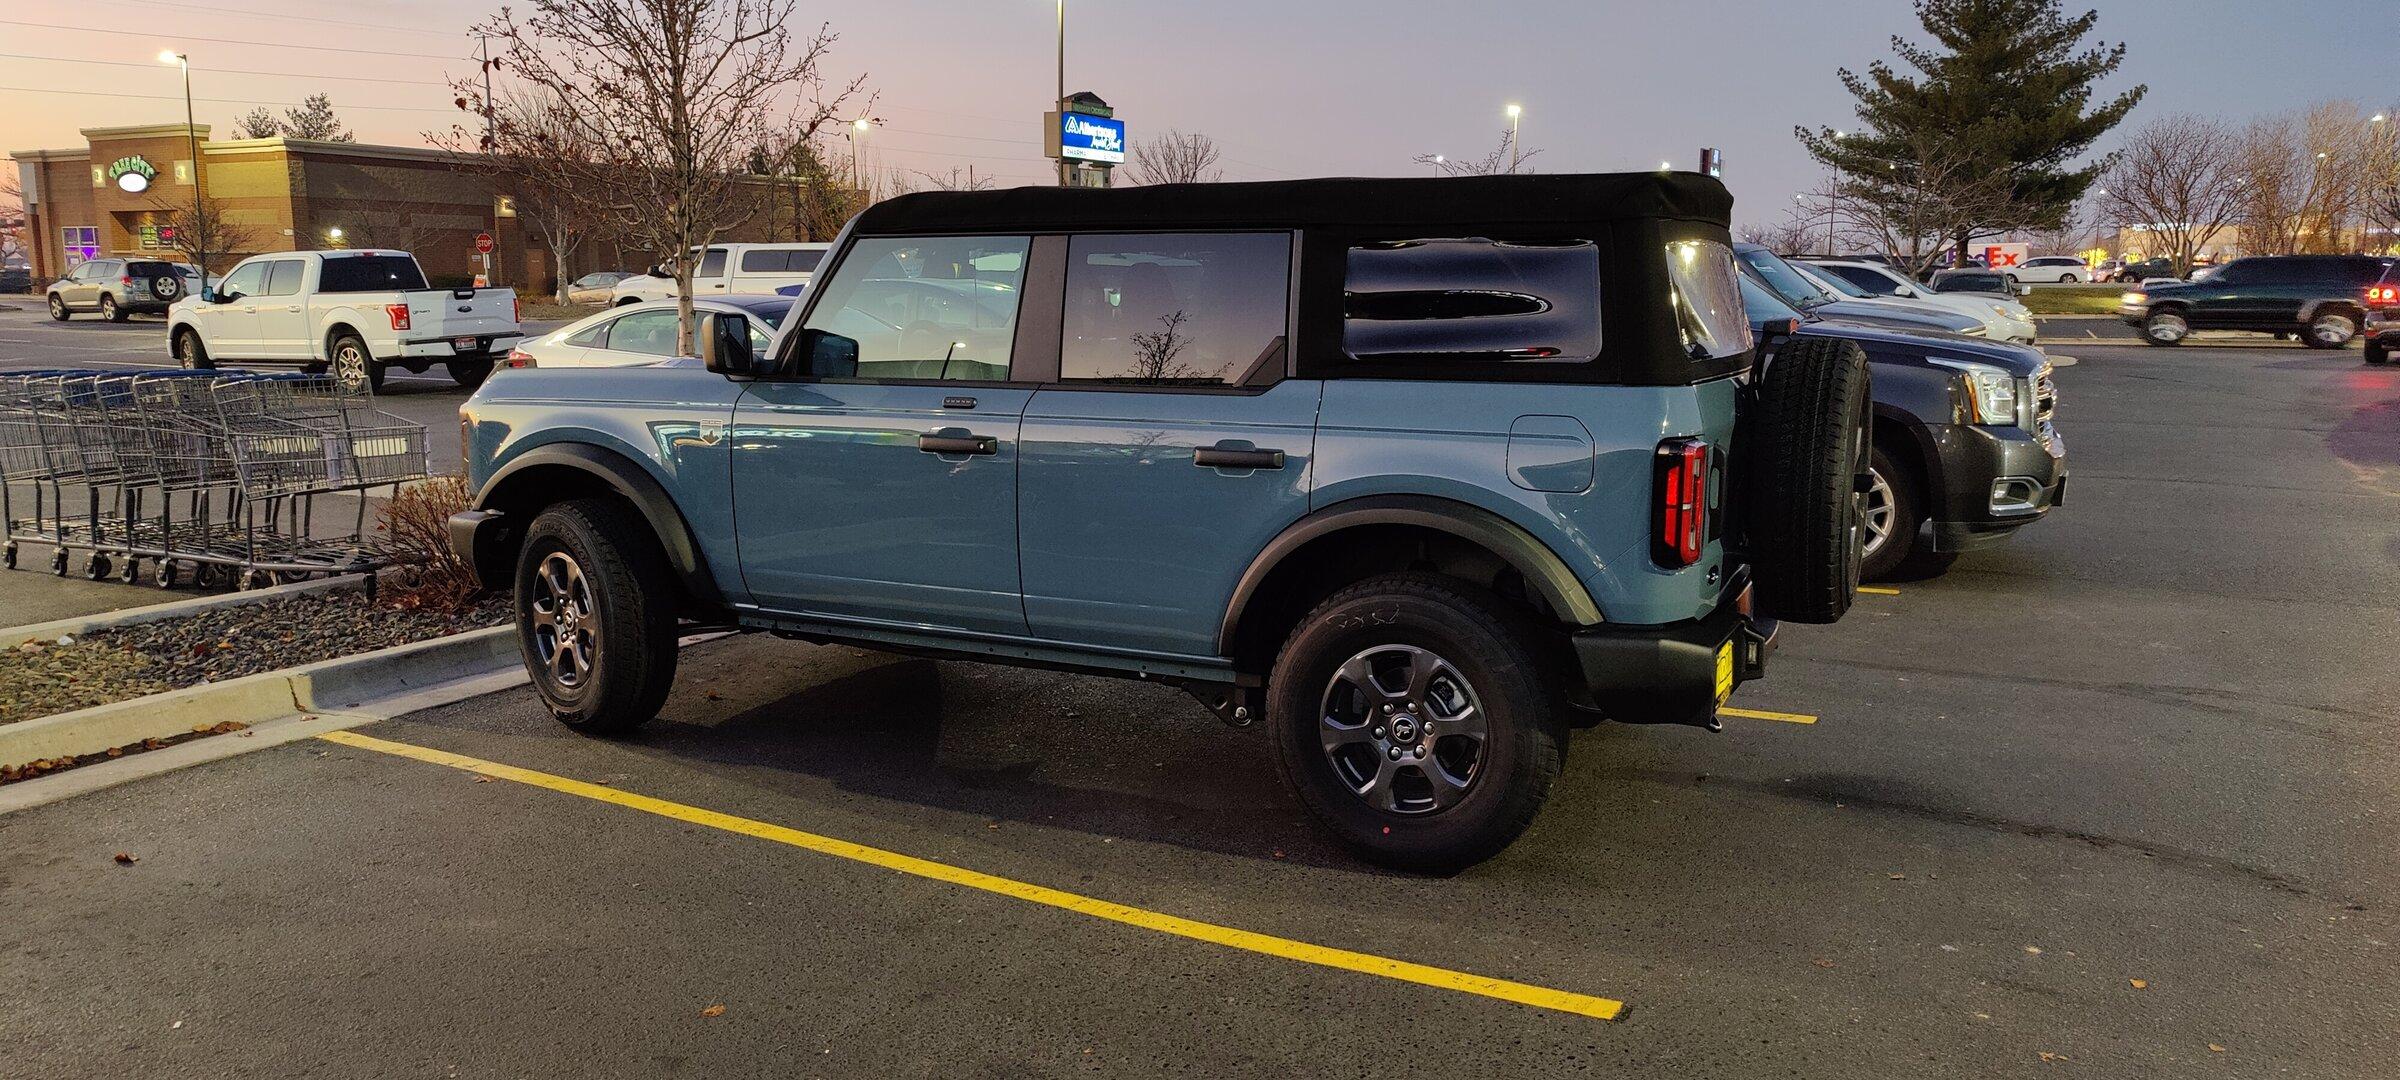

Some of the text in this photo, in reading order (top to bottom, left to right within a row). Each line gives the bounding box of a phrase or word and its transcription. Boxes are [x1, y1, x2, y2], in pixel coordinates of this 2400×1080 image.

[109, 155, 154, 180] TREE CITY
[477, 240, 492, 248] STOP
